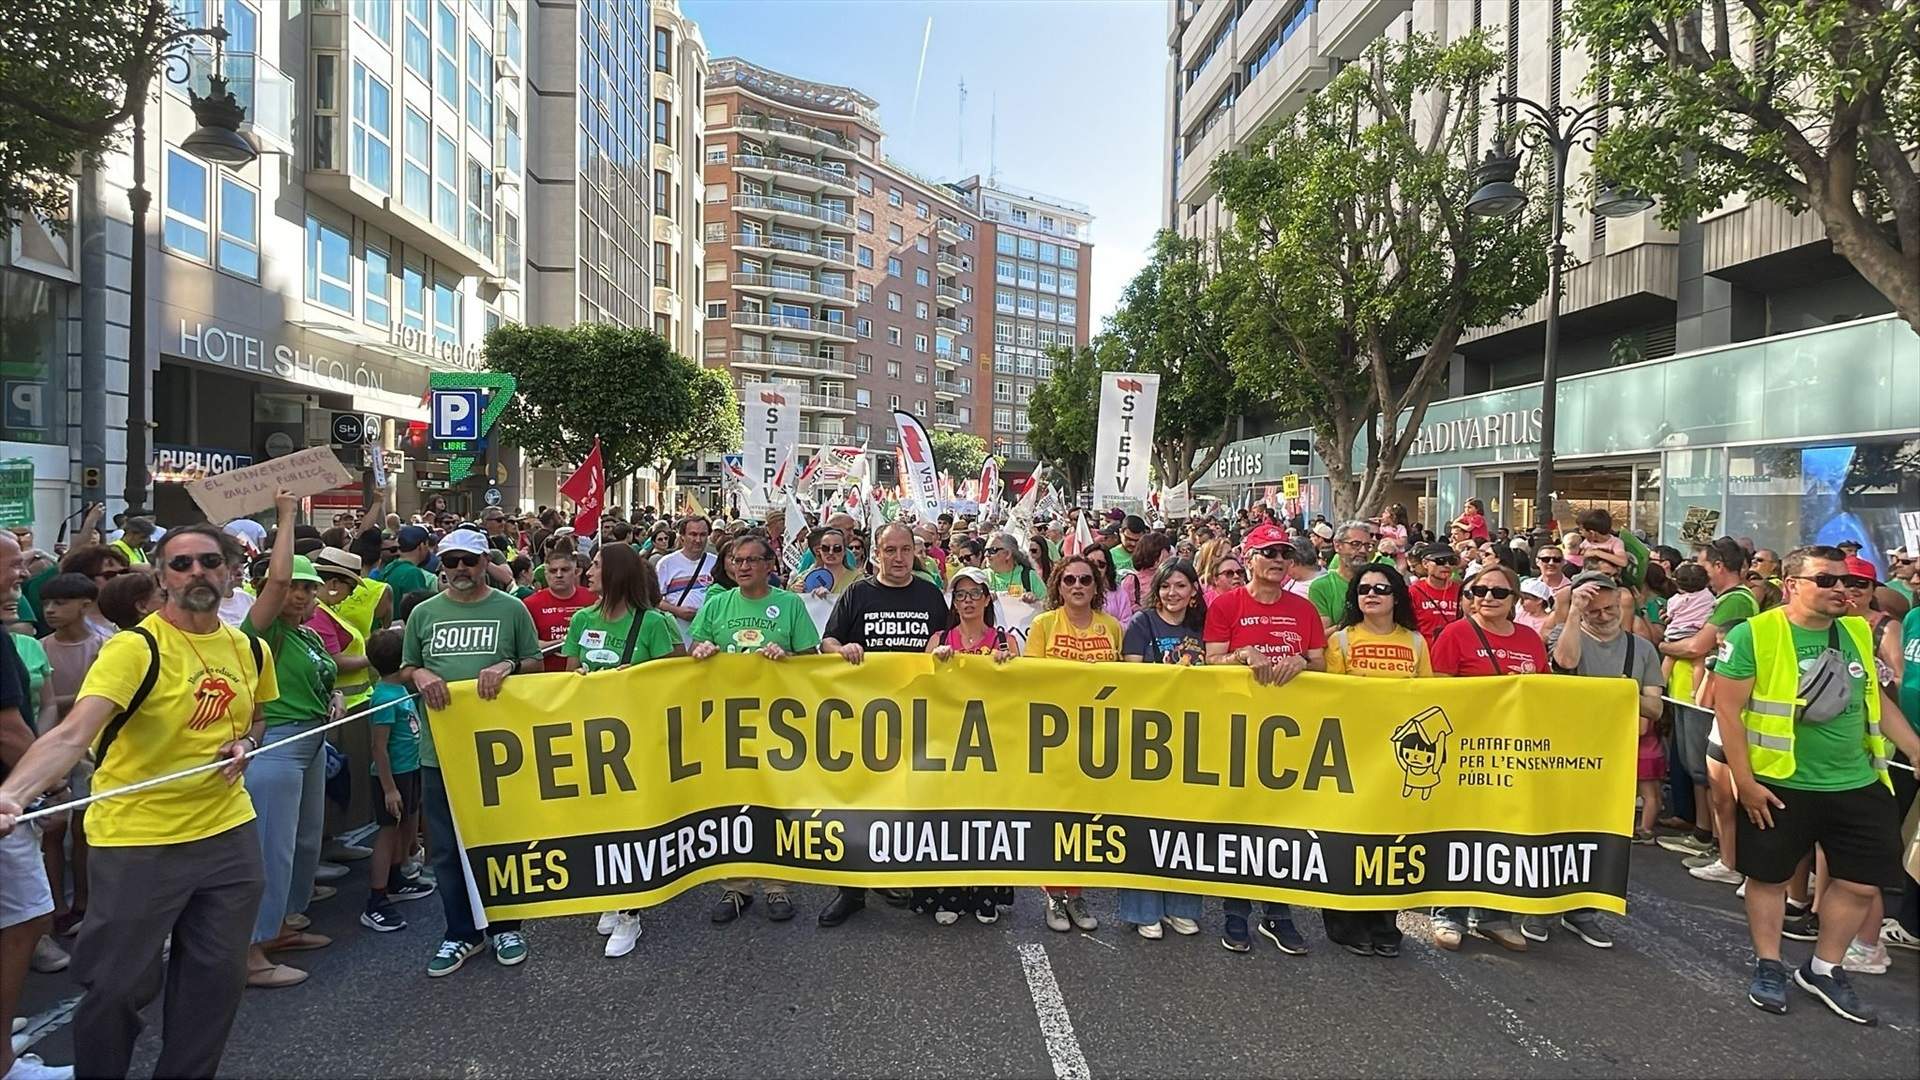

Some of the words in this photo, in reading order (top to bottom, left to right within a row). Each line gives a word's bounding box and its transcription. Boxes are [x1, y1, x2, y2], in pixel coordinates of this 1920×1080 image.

[180, 319, 272, 375] HOTEL
[339, 425, 356, 433] SH
[1377, 408, 1543, 455] RADIVARIUS
[443, 442, 467, 450] LIBRE
[1115, 394, 1135, 493] STEPV
[763, 407, 778, 503] STEPV
[1215, 446, 1262, 478] lefties
[864, 612, 879, 620] PER
[880, 611, 896, 619] UNA
[1240, 616, 1260, 626] UGT
[864, 618, 929, 636] PÚBLICA
[434, 627, 494, 650] SOUTH
[870, 638, 884, 647] DE
[885, 637, 928, 648] QUALITAT
[1053, 648, 1115, 661] educació
[1352, 659, 1415, 673] educació
[473, 717, 636, 807] PER
[667, 697, 998, 783] L'ESCOLA
[1028, 686, 1354, 794] PÚBLICA
[1460, 738, 1551, 752] PLATAFORMA
[1459, 755, 1485, 769] PER
[1492, 755, 1603, 770] L'ENSENYAMENT
[1458, 769, 1514, 788] PÚBLIC
[487, 841, 570, 897] MÉS
[594, 804, 754, 887] INVERSIÓ
[775, 808, 845, 863] MÉS
[868, 820, 1032, 864] QUALITAT
[1054, 814, 1127, 865] MÉS
[1148, 828, 1329, 884] VALENCIÀ
[1355, 834, 1425, 886] MÉS
[1447, 841, 1598, 888] DIGNITAT
